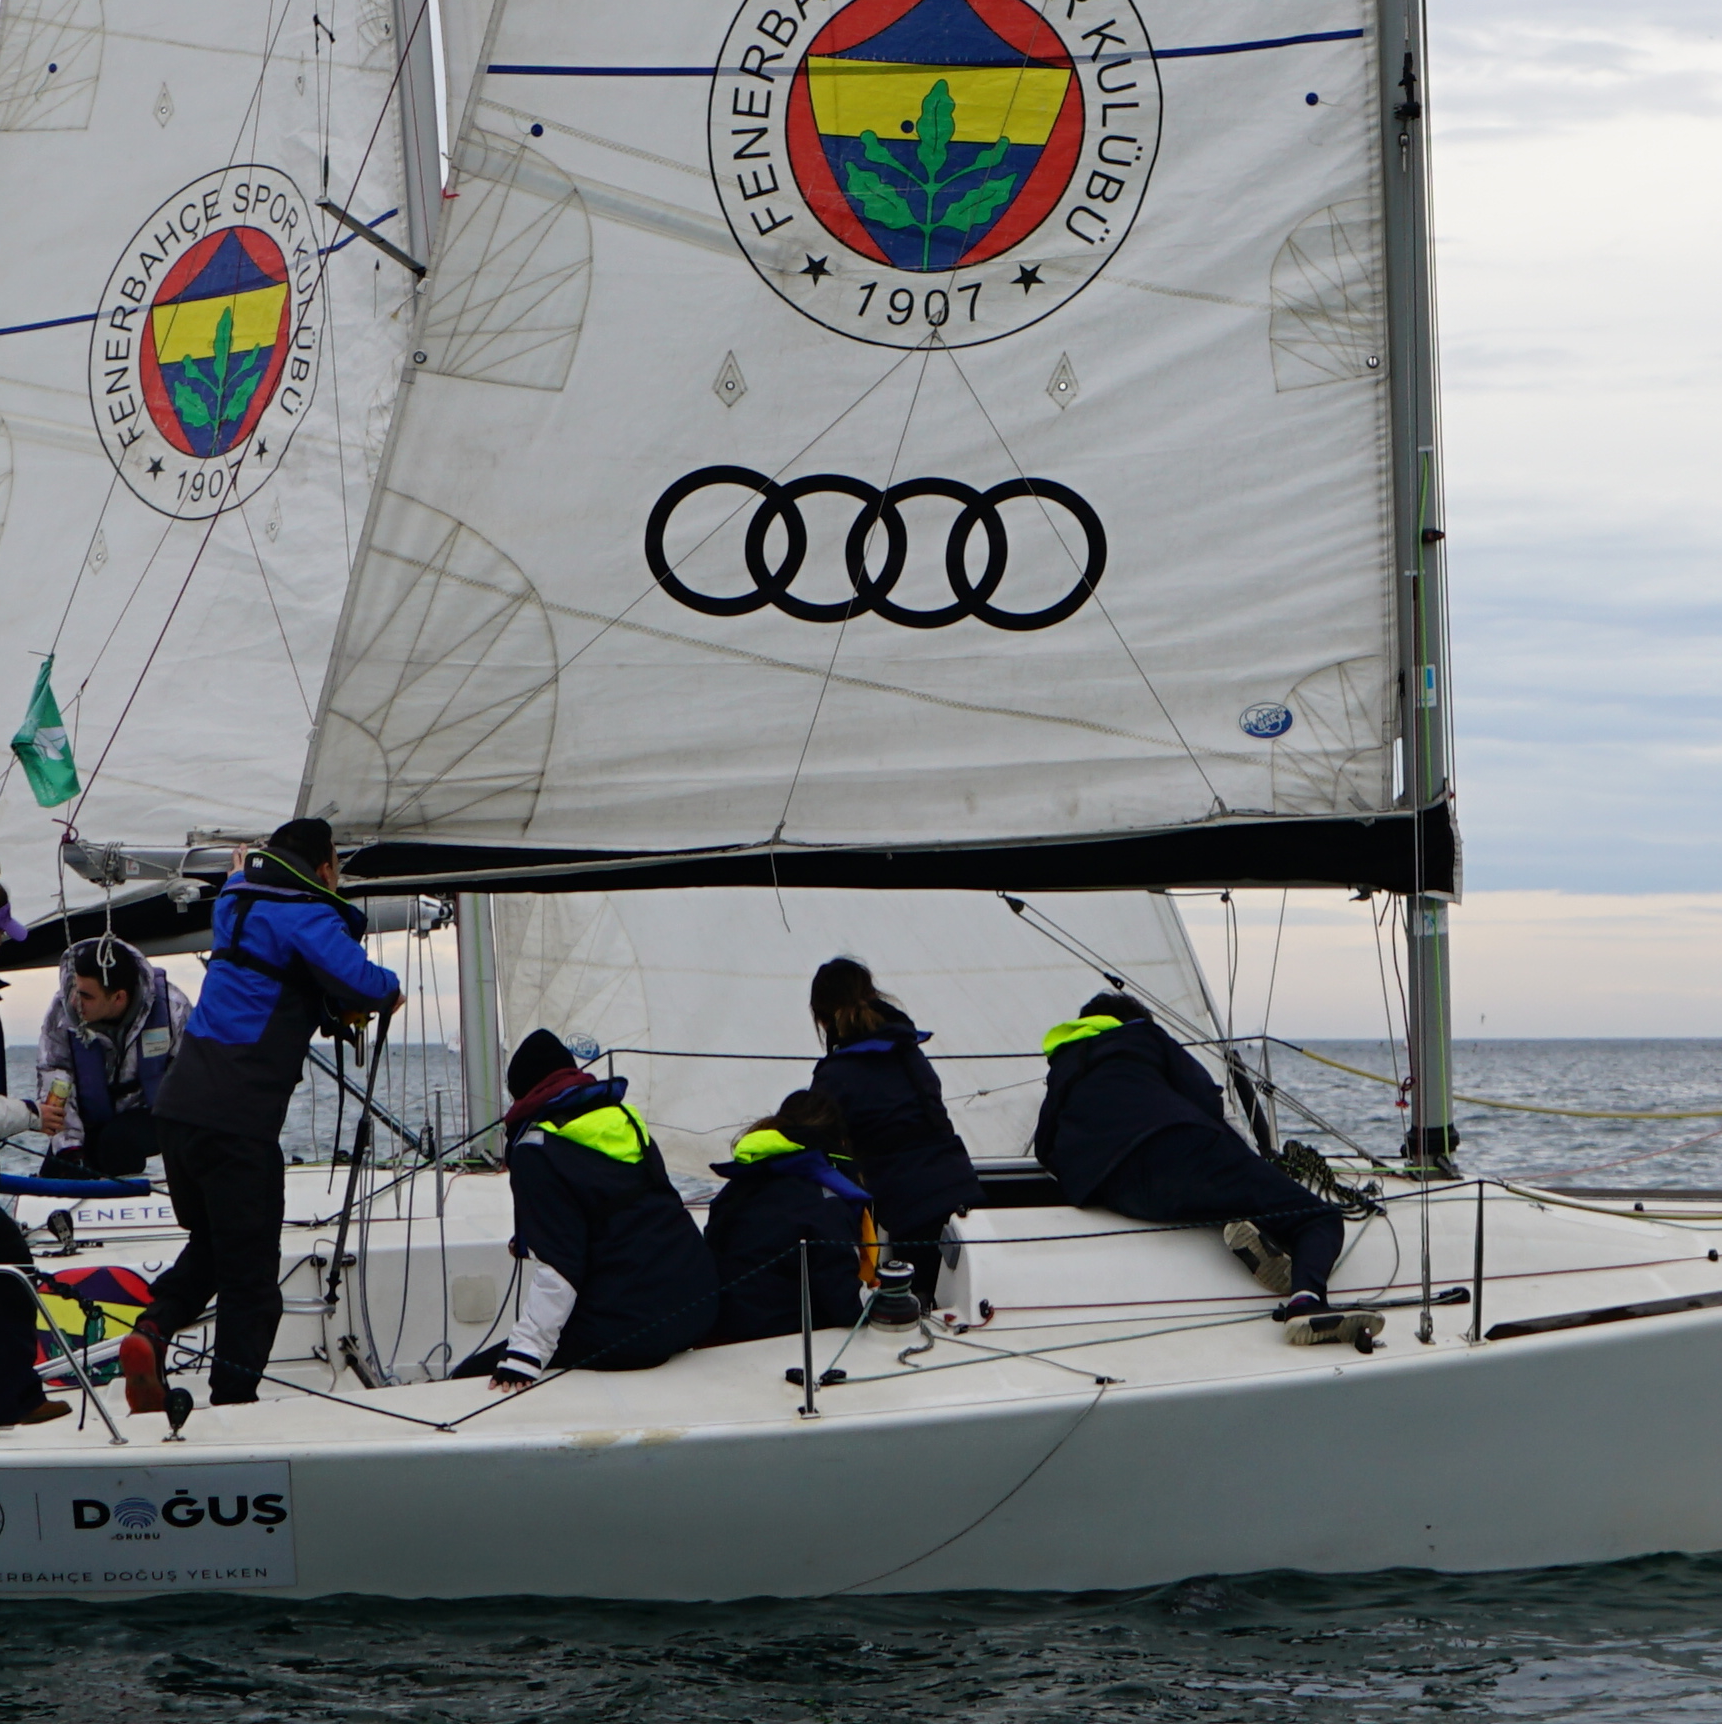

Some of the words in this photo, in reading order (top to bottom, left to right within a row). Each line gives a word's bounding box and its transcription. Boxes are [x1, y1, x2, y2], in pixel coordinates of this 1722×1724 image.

[1065, 19, 1145, 247] KULÜBÜ
[104, 190, 222, 449] FENERBAHÇE
[233, 183, 298, 243] SPOR
[280, 237, 315, 416] KULÜBÜ
[858, 281, 983, 326] 1907
[177, 458, 242, 502] 1907
[78, 1206, 174, 1222] ENETE
[73, 1489, 287, 1533] DOĞUŞ
[115, 1533, 160, 1541] GRUBU
[104, 1569, 178, 1583] DOĞUŞ
[187, 1567, 267, 1579] YELKEN
